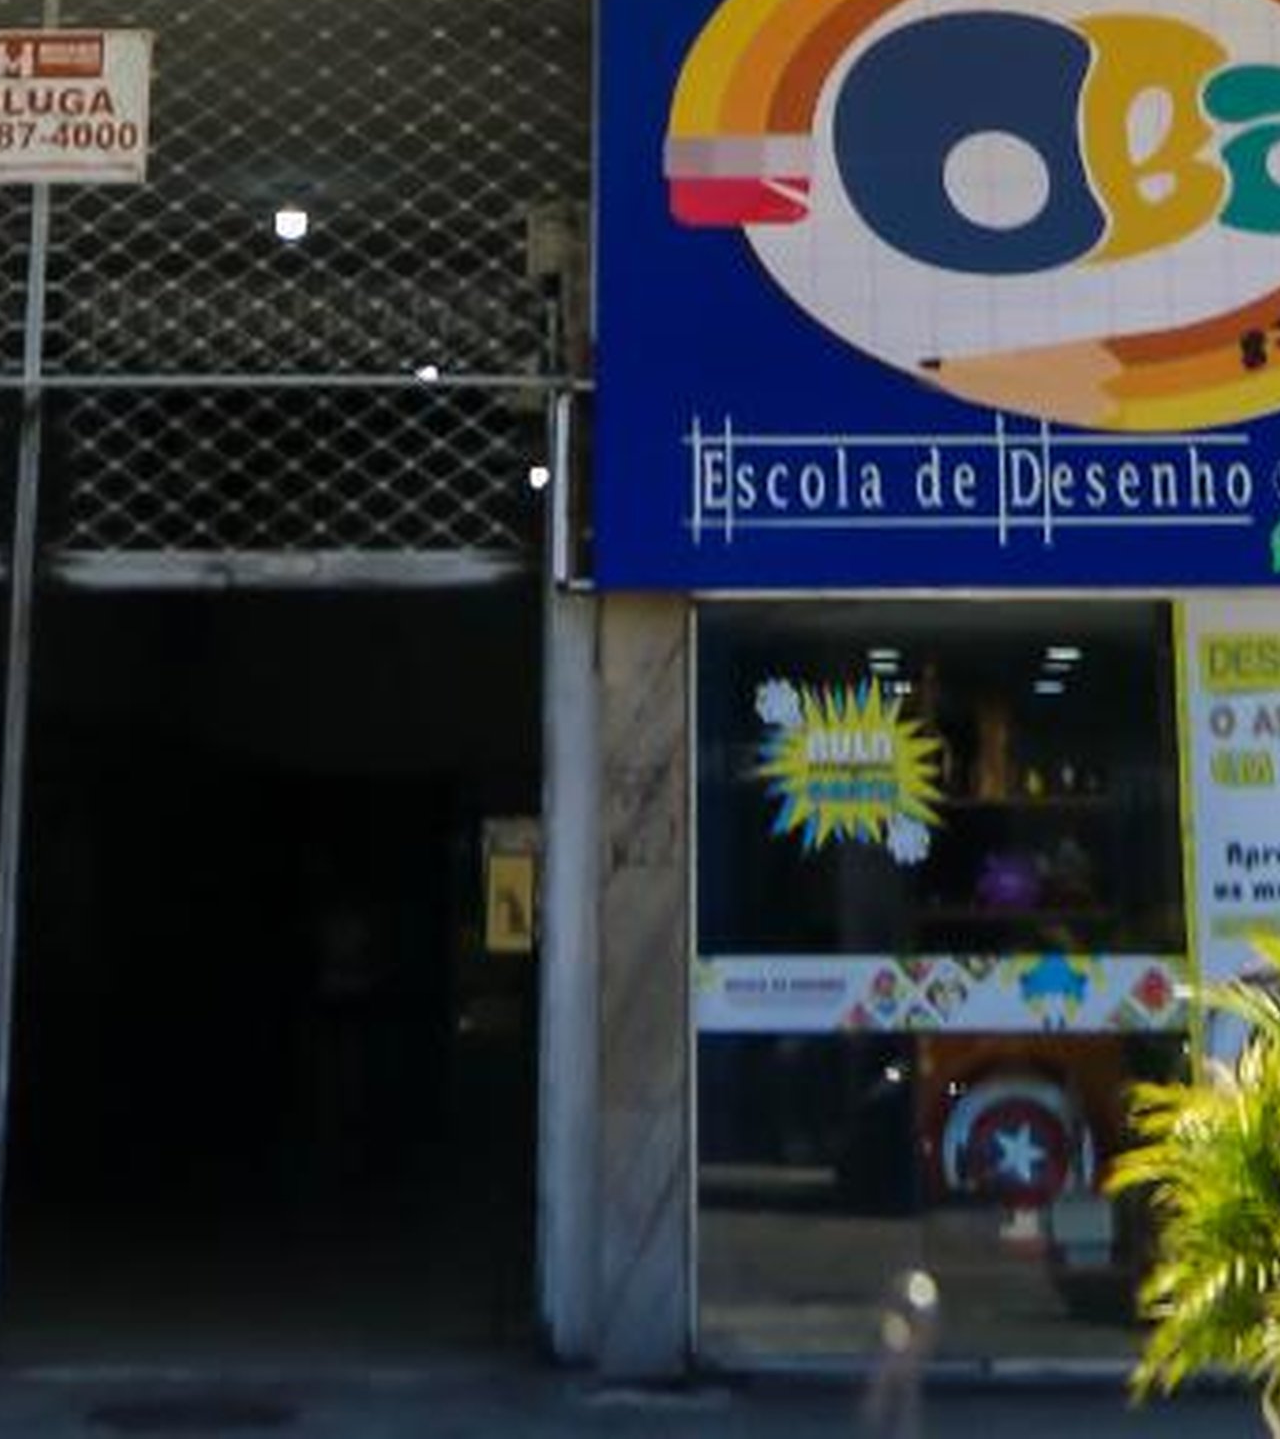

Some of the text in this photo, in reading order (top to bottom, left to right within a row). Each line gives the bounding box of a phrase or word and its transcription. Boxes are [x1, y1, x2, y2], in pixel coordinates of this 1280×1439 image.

[703, 444, 1253, 509] Escola de Desenho
[1210, 704, 1237, 738] O
